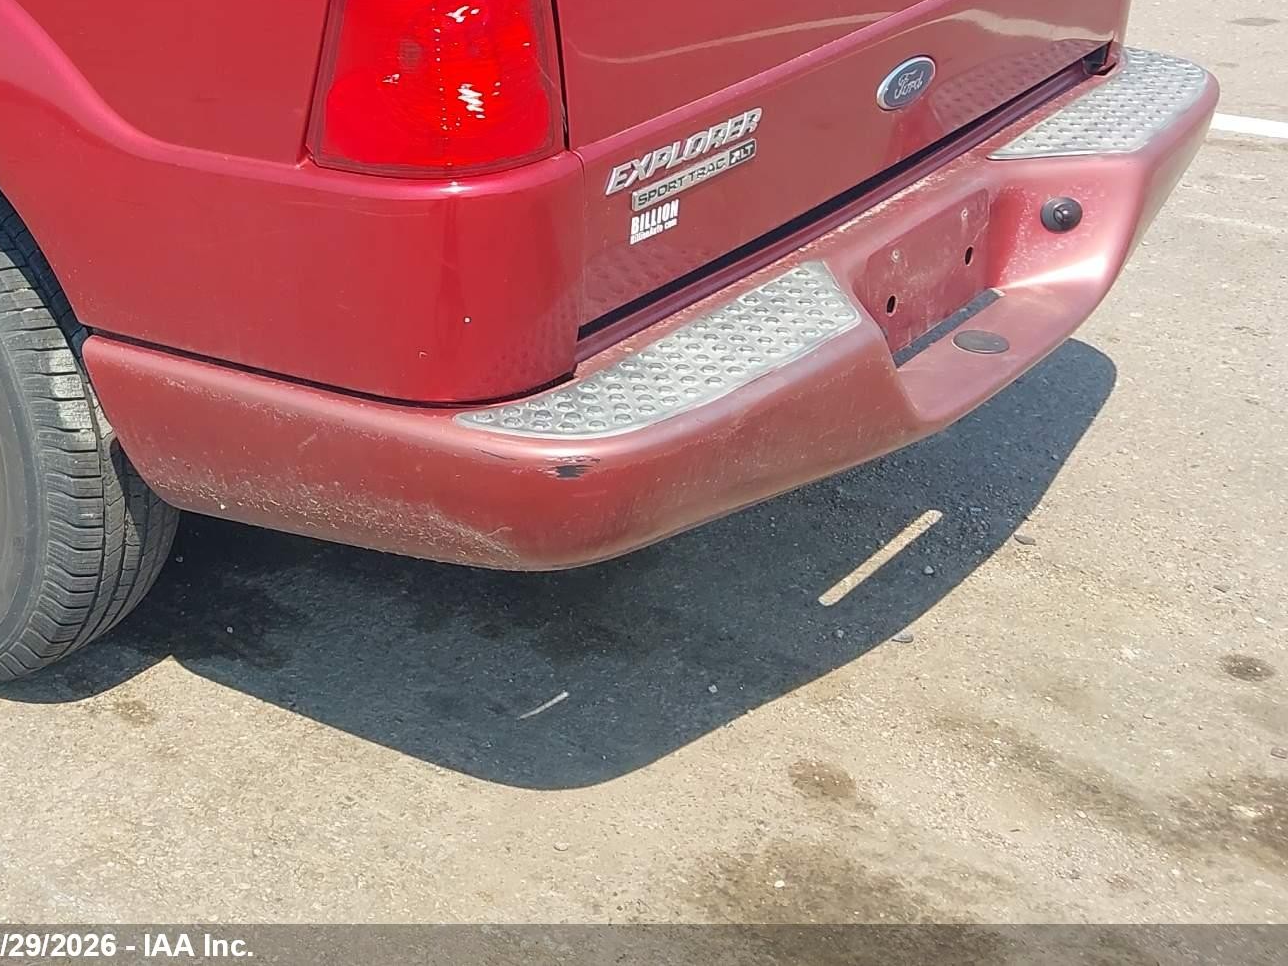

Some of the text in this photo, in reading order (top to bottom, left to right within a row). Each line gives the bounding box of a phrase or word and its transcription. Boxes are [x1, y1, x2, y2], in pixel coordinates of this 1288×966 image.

[605, 108, 762, 195] EXPLORER
[638, 176, 687, 206] SPORT
[689, 157, 726, 182] TRAC
[630, 198, 680, 235] BILLION
